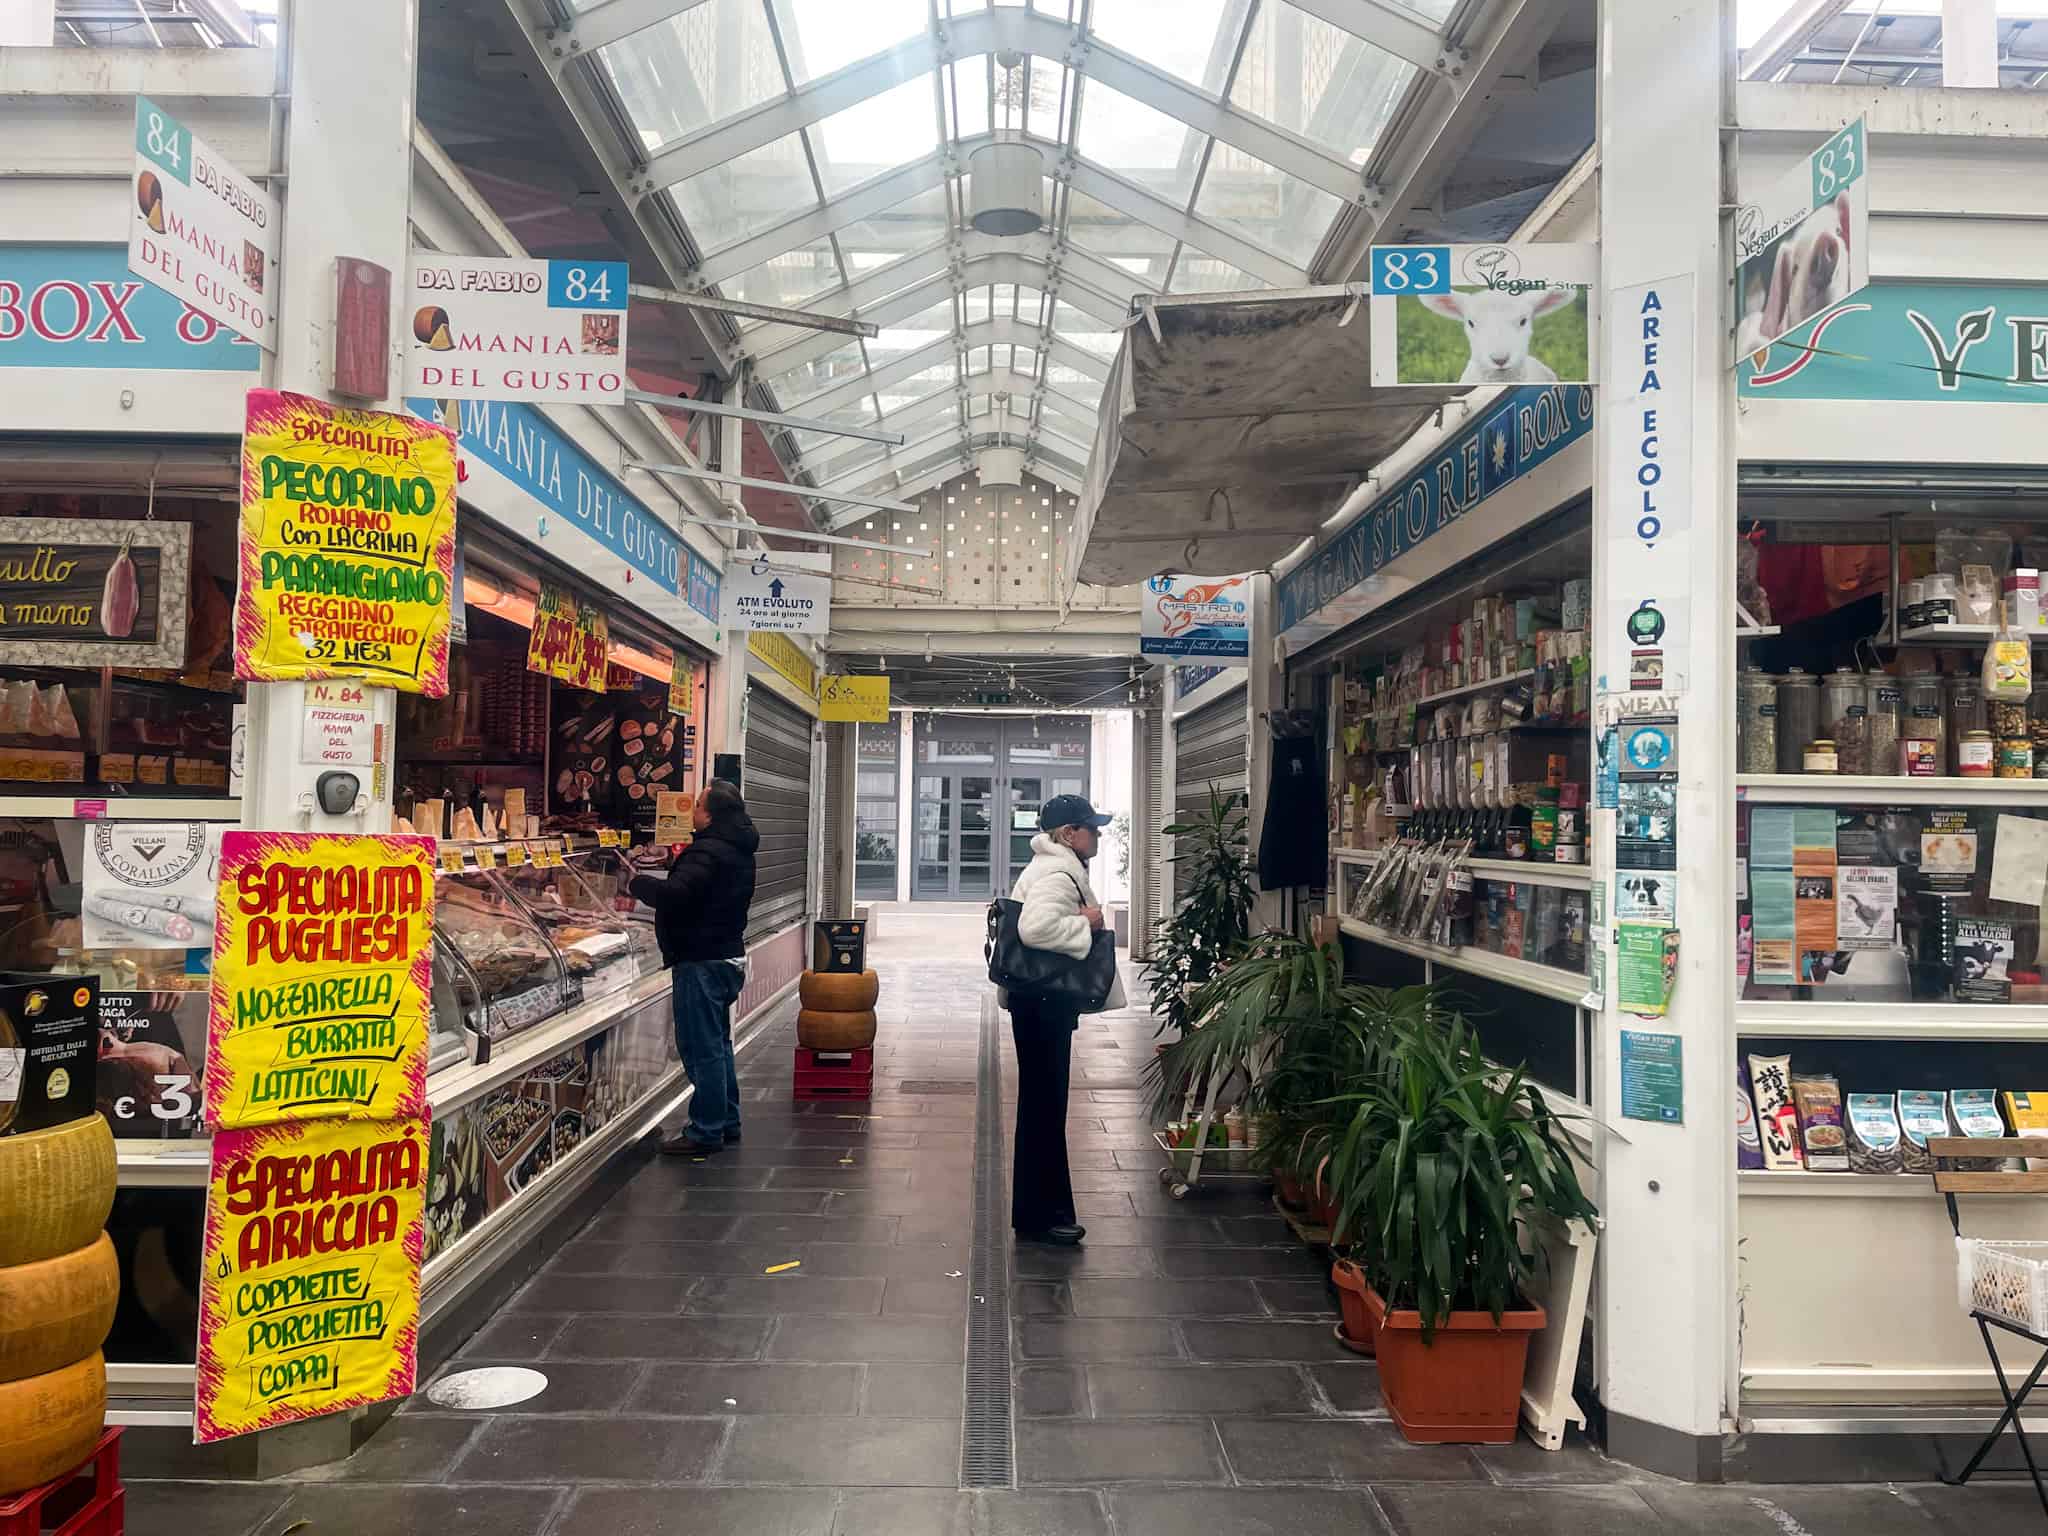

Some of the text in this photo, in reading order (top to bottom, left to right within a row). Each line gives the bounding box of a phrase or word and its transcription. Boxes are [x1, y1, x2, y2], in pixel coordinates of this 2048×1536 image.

[147, 112, 181, 169] 84
[1818, 134, 1855, 197] 83
[195, 157, 266, 228] DA FABIO
[168, 211, 239, 276] MANIA
[142, 238, 264, 329] DEL GUSTO
[417, 268, 542, 293] DA FABIO
[565, 268, 612, 302] 84
[1384, 252, 1439, 290] 83
[1478, 270, 1546, 296] Vegan
[177, 300, 254, 343] 8
[459, 334, 574, 354] MANIA
[422, 367, 622, 392] DEL GUSTO
[1637, 291, 1662, 549] AREA ECOLO
[261, 455, 436, 515] PECORINO
[467, 400, 563, 502] MANIA
[623, 511, 679, 584] GUSTO
[1373, 434, 1480, 568] STORE
[1520, 385, 1572, 463] BOX
[300, 502, 391, 531] ROMANO
[327, 526, 418, 554] LACRIMA
[261, 550, 444, 607] PARMIGIANO
[13, 603, 93, 626] mano
[278, 593, 394, 625] REGGIANO
[737, 597, 814, 609] ATM EVOLUTO
[781, 610, 810, 619] giorno
[1163, 602, 1232, 613] MASTRO
[289, 617, 419, 647] STRAVECCHIO
[305, 639, 392, 662] 32 MESI
[314, 686, 363, 703] N. 84
[311, 711, 365, 723] PIZZICHERIA
[323, 724, 352, 734] MANIA
[322, 750, 352, 760] GUSTO
[329, 738, 348, 746] DEL
[132, 837, 166, 845] VILLANI
[111, 854, 189, 880] CORALLINA
[247, 915, 410, 966] PUGLIESI
[237, 973, 393, 1030] MOZZARELLA
[104, 1019, 150, 1029] A MANO
[286, 1018, 396, 1060] BURRATA
[251, 1066, 368, 1103] LATTICINI
[114, 1096, 136, 1119] €
[226, 1126, 421, 1216] SPECIALITÀ
[218, 1196, 399, 1281] di ARICCIA
[236, 1267, 363, 1317] COPPIETTE
[248, 1300, 385, 1356] PORCHETTA
[258, 1355, 329, 1397] COPPA
